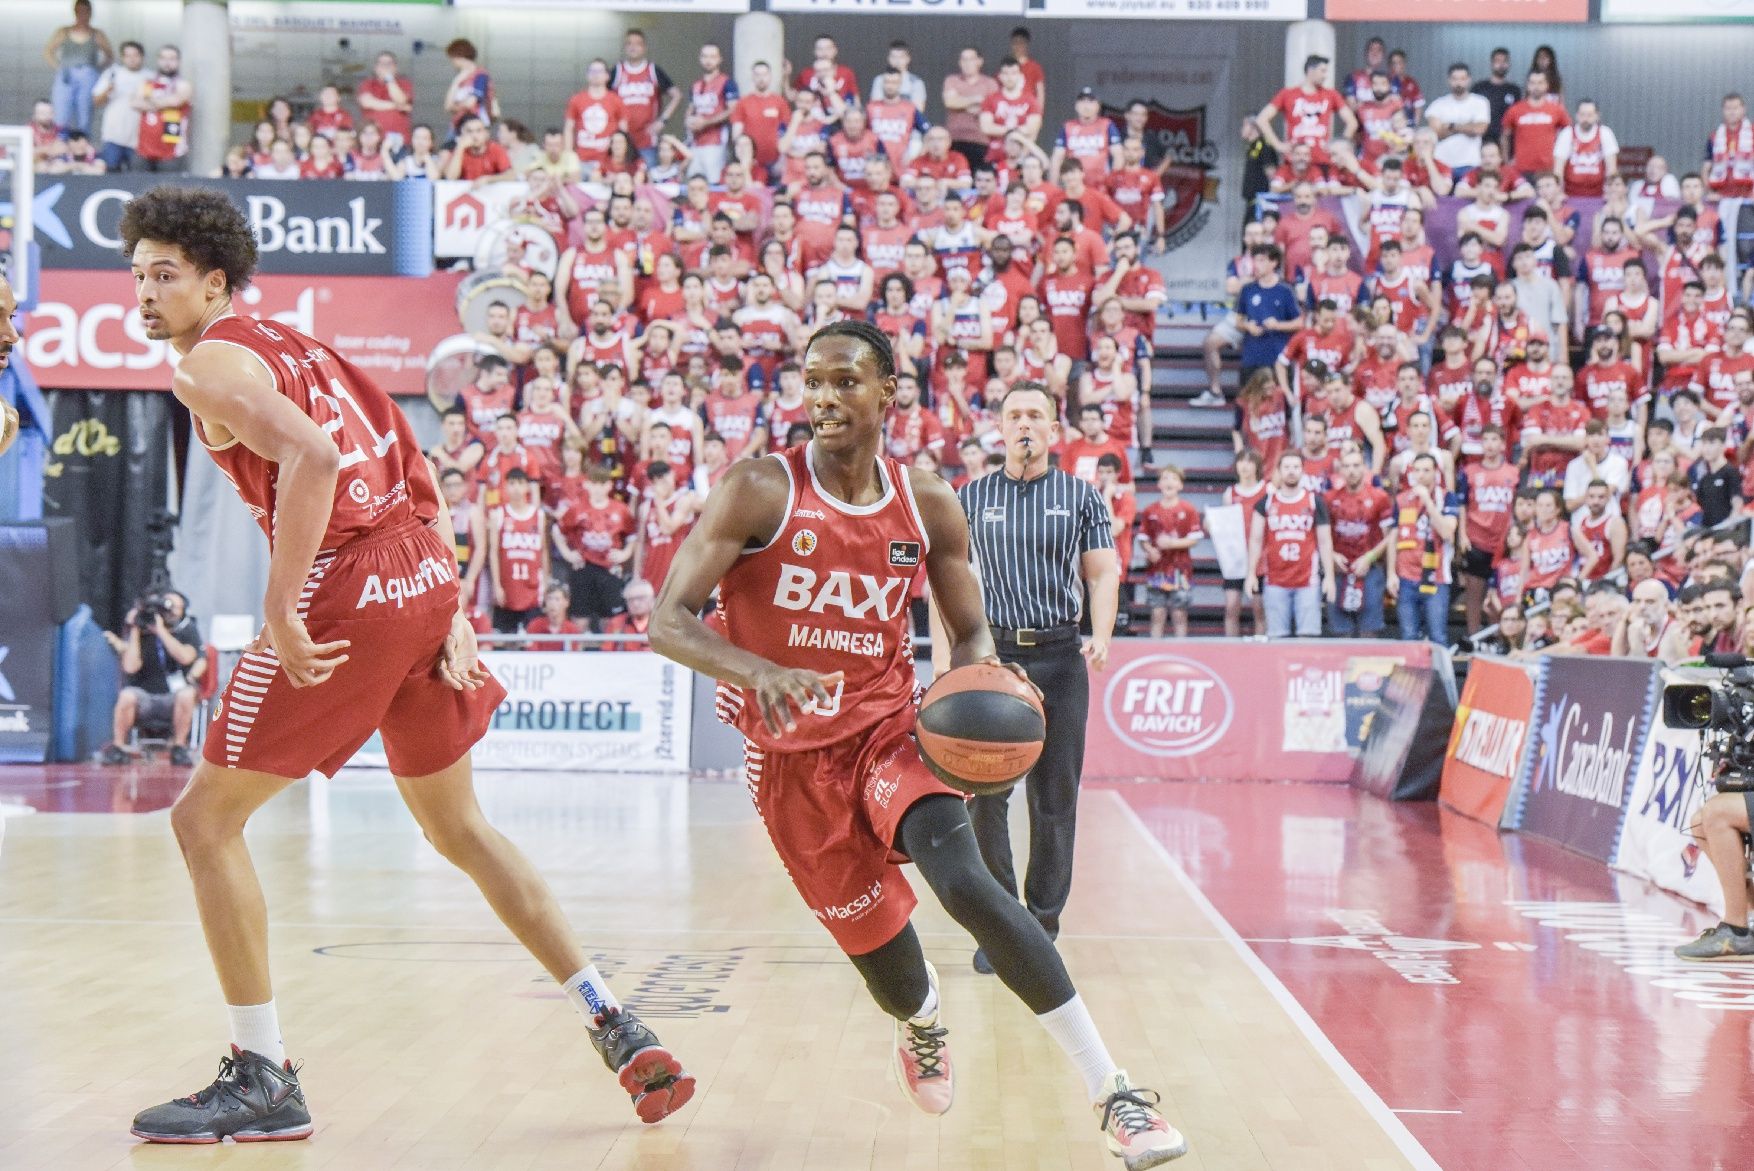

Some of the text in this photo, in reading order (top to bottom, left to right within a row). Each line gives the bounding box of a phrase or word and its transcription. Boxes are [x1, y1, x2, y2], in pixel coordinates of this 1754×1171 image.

[80, 188, 386, 254] CBank
[309, 376, 398, 470] 21
[1279, 543, 1300, 561] 42
[772, 562, 912, 622] BAXI
[787, 624, 884, 658] MANRESA
[497, 663, 555, 692] SHIP
[1122, 678, 1215, 715] FRIT
[494, 699, 633, 731] PROTECT
[1130, 713, 1203, 734] RAVICH
[825, 893, 872, 921] Macsa
